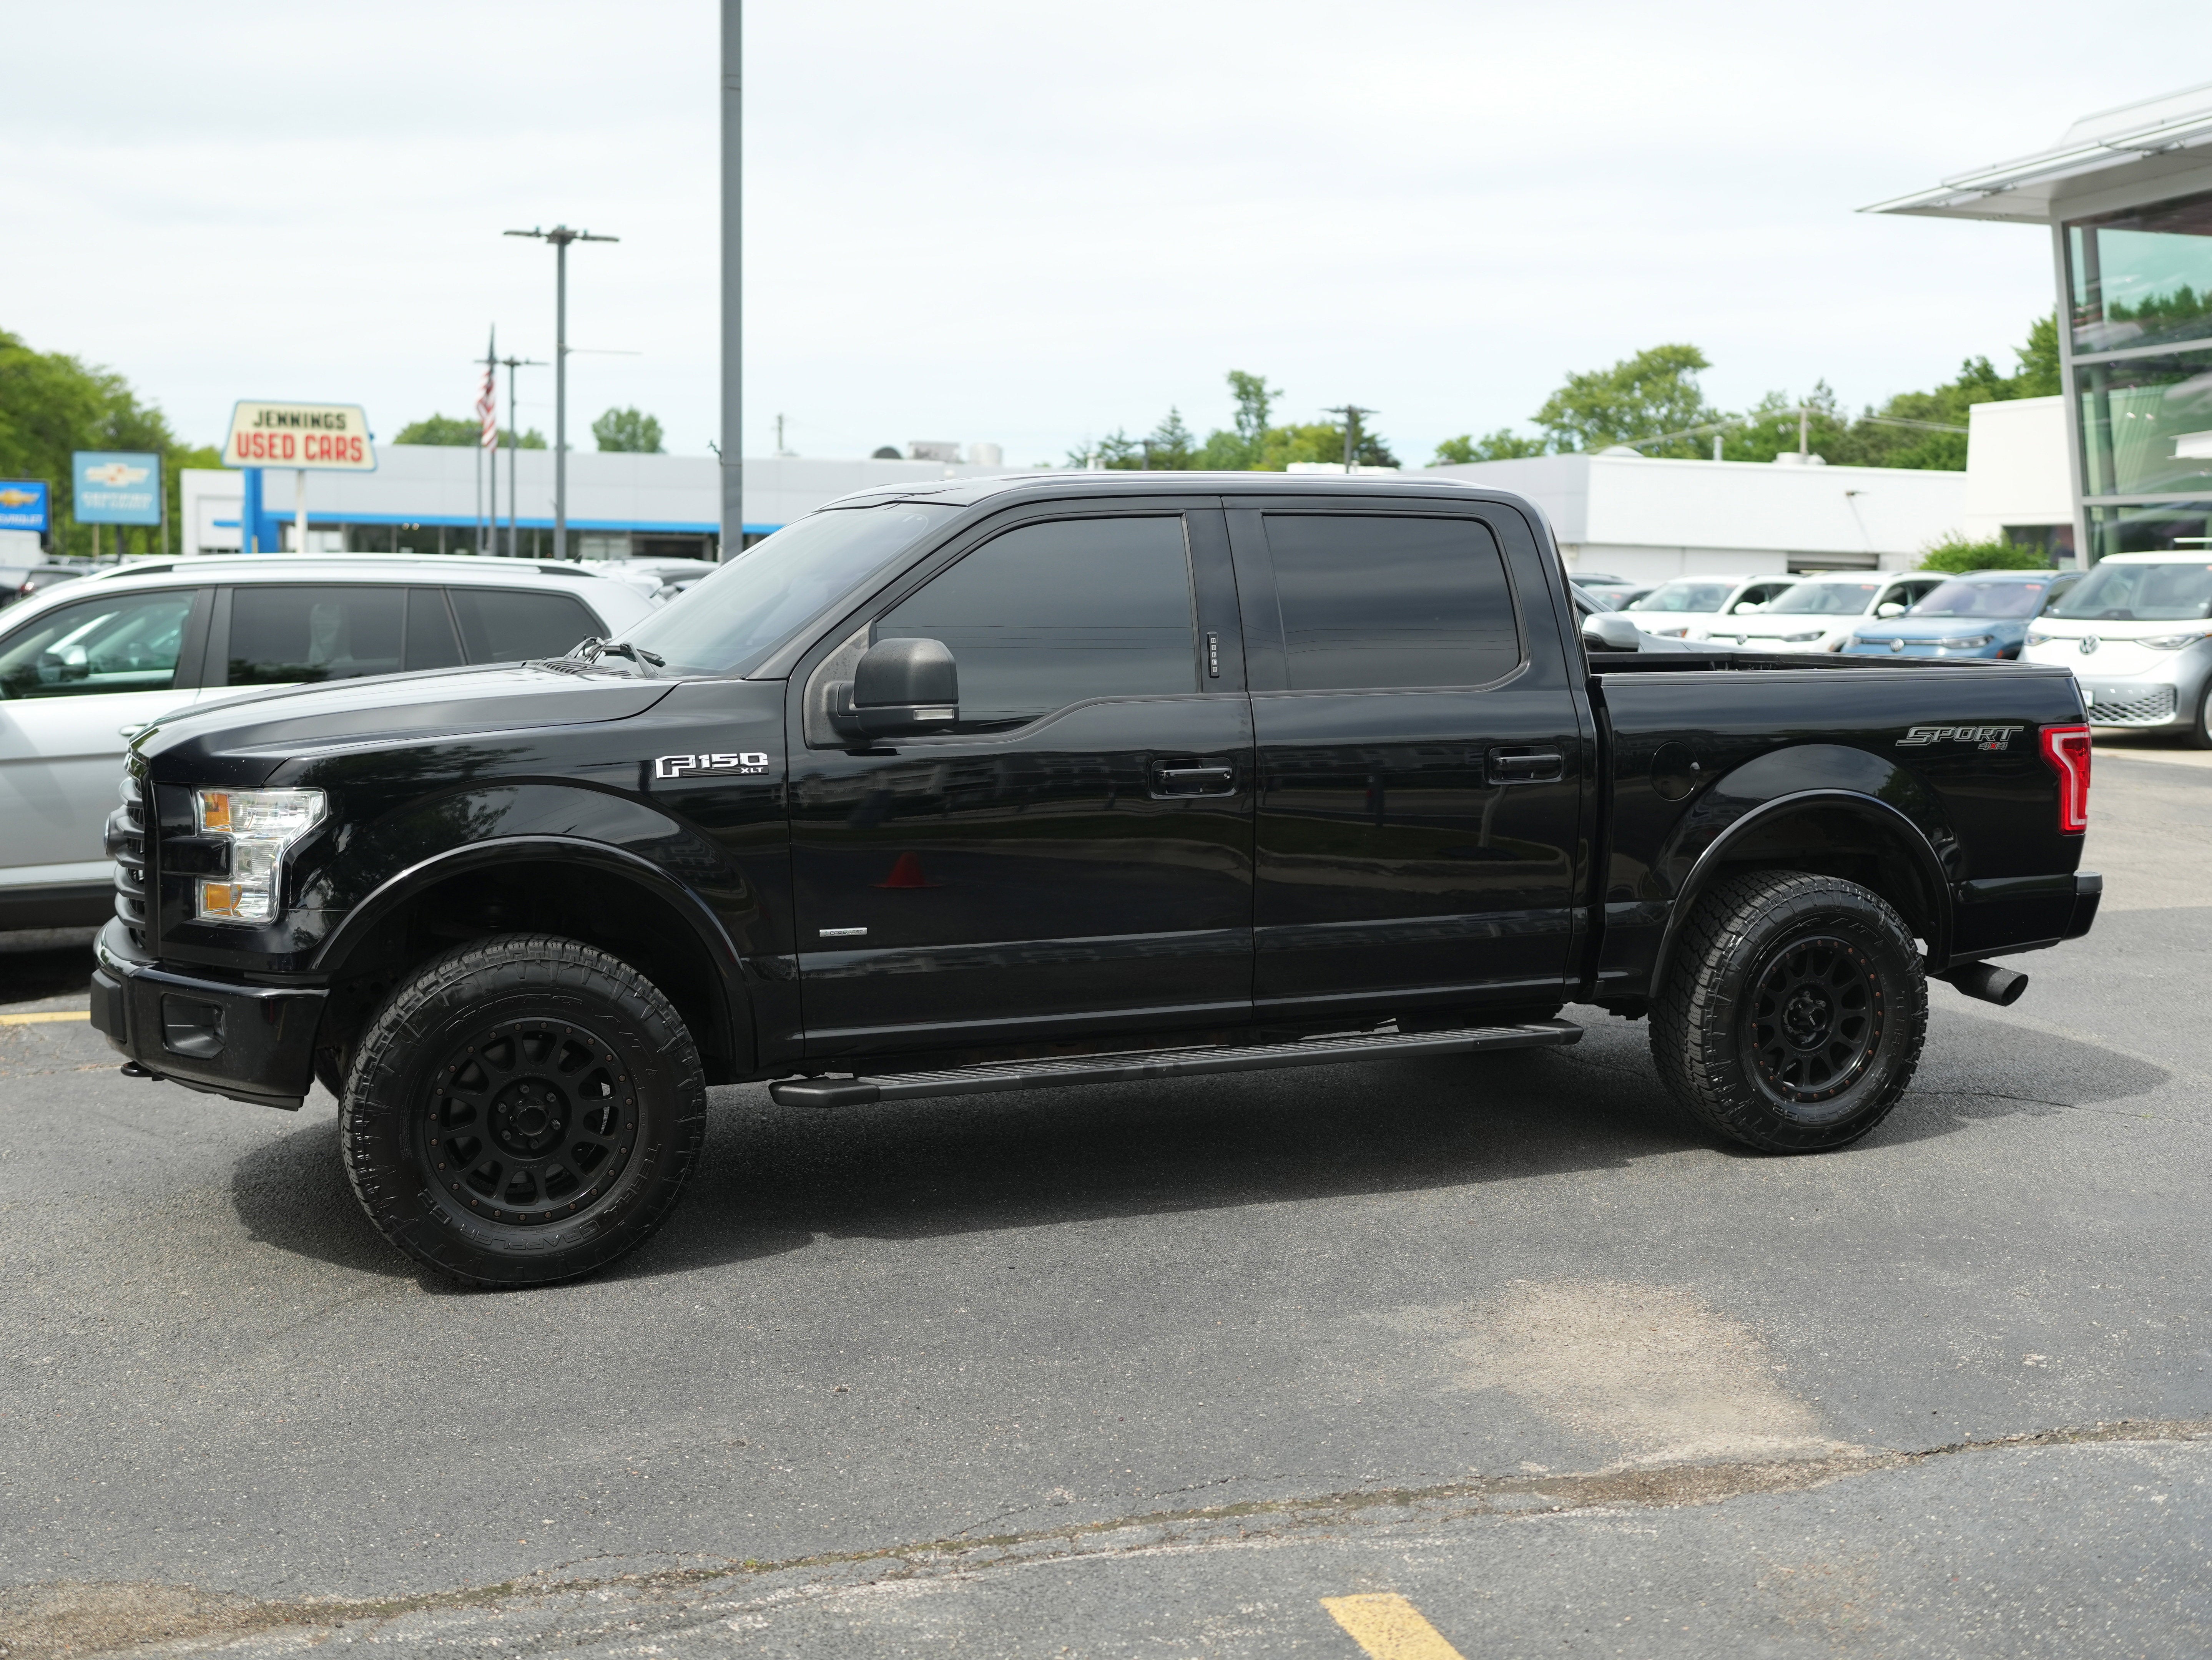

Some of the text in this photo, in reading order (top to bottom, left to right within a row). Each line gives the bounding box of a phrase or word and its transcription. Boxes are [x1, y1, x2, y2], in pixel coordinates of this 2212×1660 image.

[253, 410, 346, 430] JENNINGS
[237, 431, 362, 462] USED CARS
[1895, 726, 2024, 746] SPORT
[460, 1220, 600, 1250] GRAPPLER
